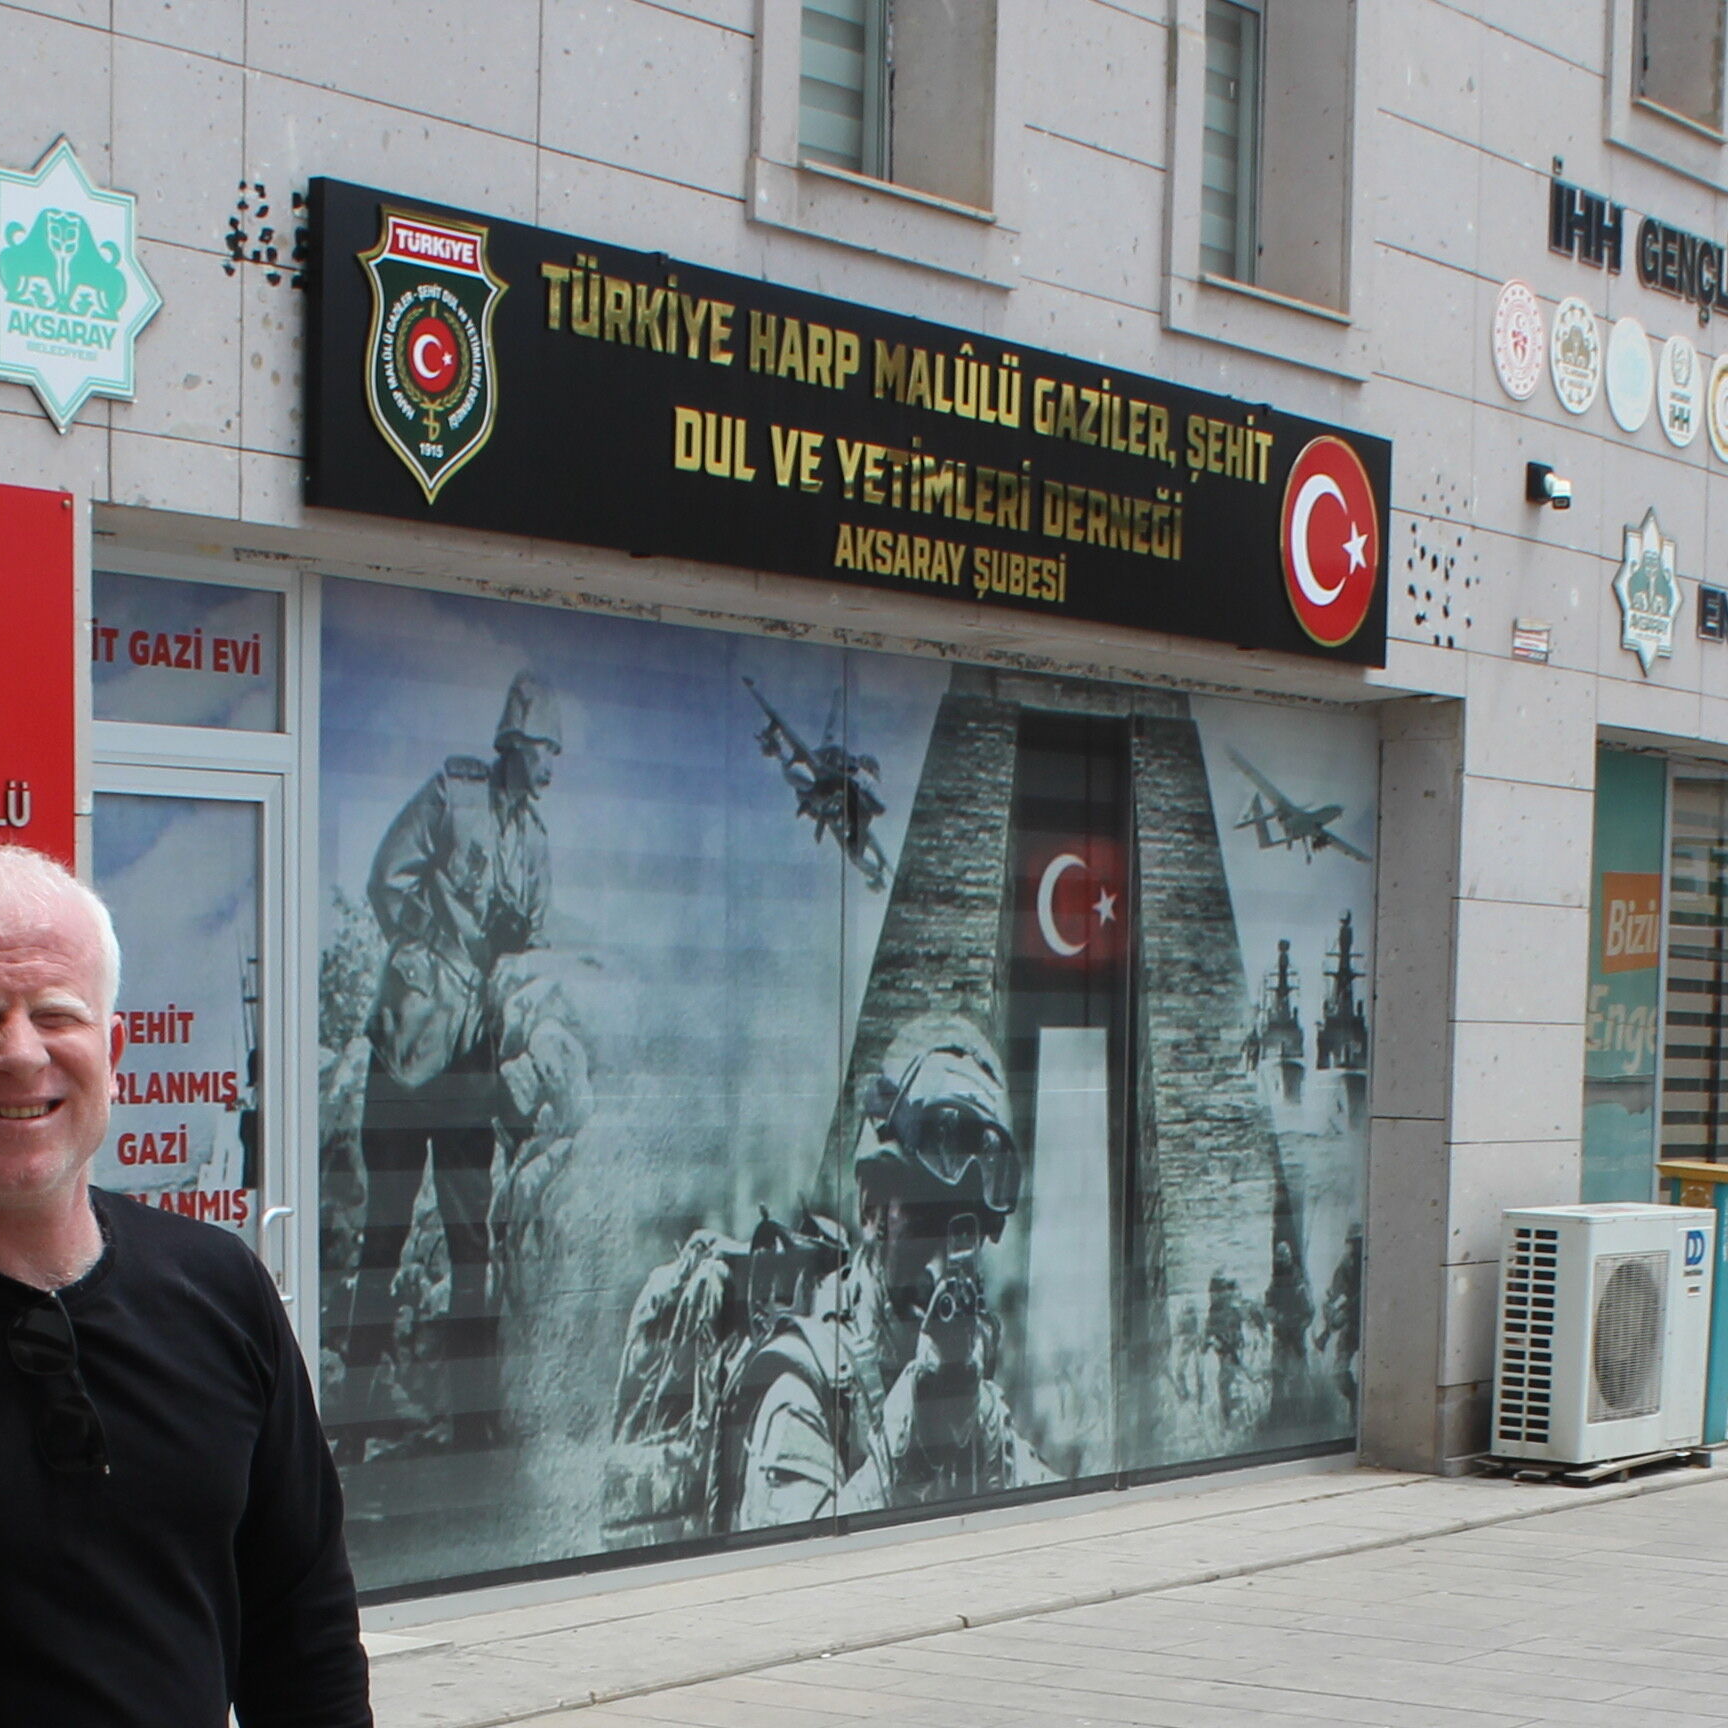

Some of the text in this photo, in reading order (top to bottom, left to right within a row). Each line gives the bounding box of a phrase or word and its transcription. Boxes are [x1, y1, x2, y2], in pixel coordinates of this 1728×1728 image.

[1548, 155, 1625, 276] İHH
[7, 309, 118, 350] AKSARAY
[541, 253, 735, 366] TÜRKİYE
[748, 310, 860, 390] HARP
[874, 340, 1022, 429] MALÛLÜ
[1186, 414, 1273, 484] ŞEHİT
[419, 441, 444, 459] 1915
[674, 406, 1184, 561] DUL VE YETİMLERİ DERNEĞİ
[834, 523, 1067, 603] AKSARAY ŞUBESİ
[128, 627, 203, 670] GAZİ
[212, 632, 261, 676] EVİ
[117, 1124, 188, 1165] GAZİ
